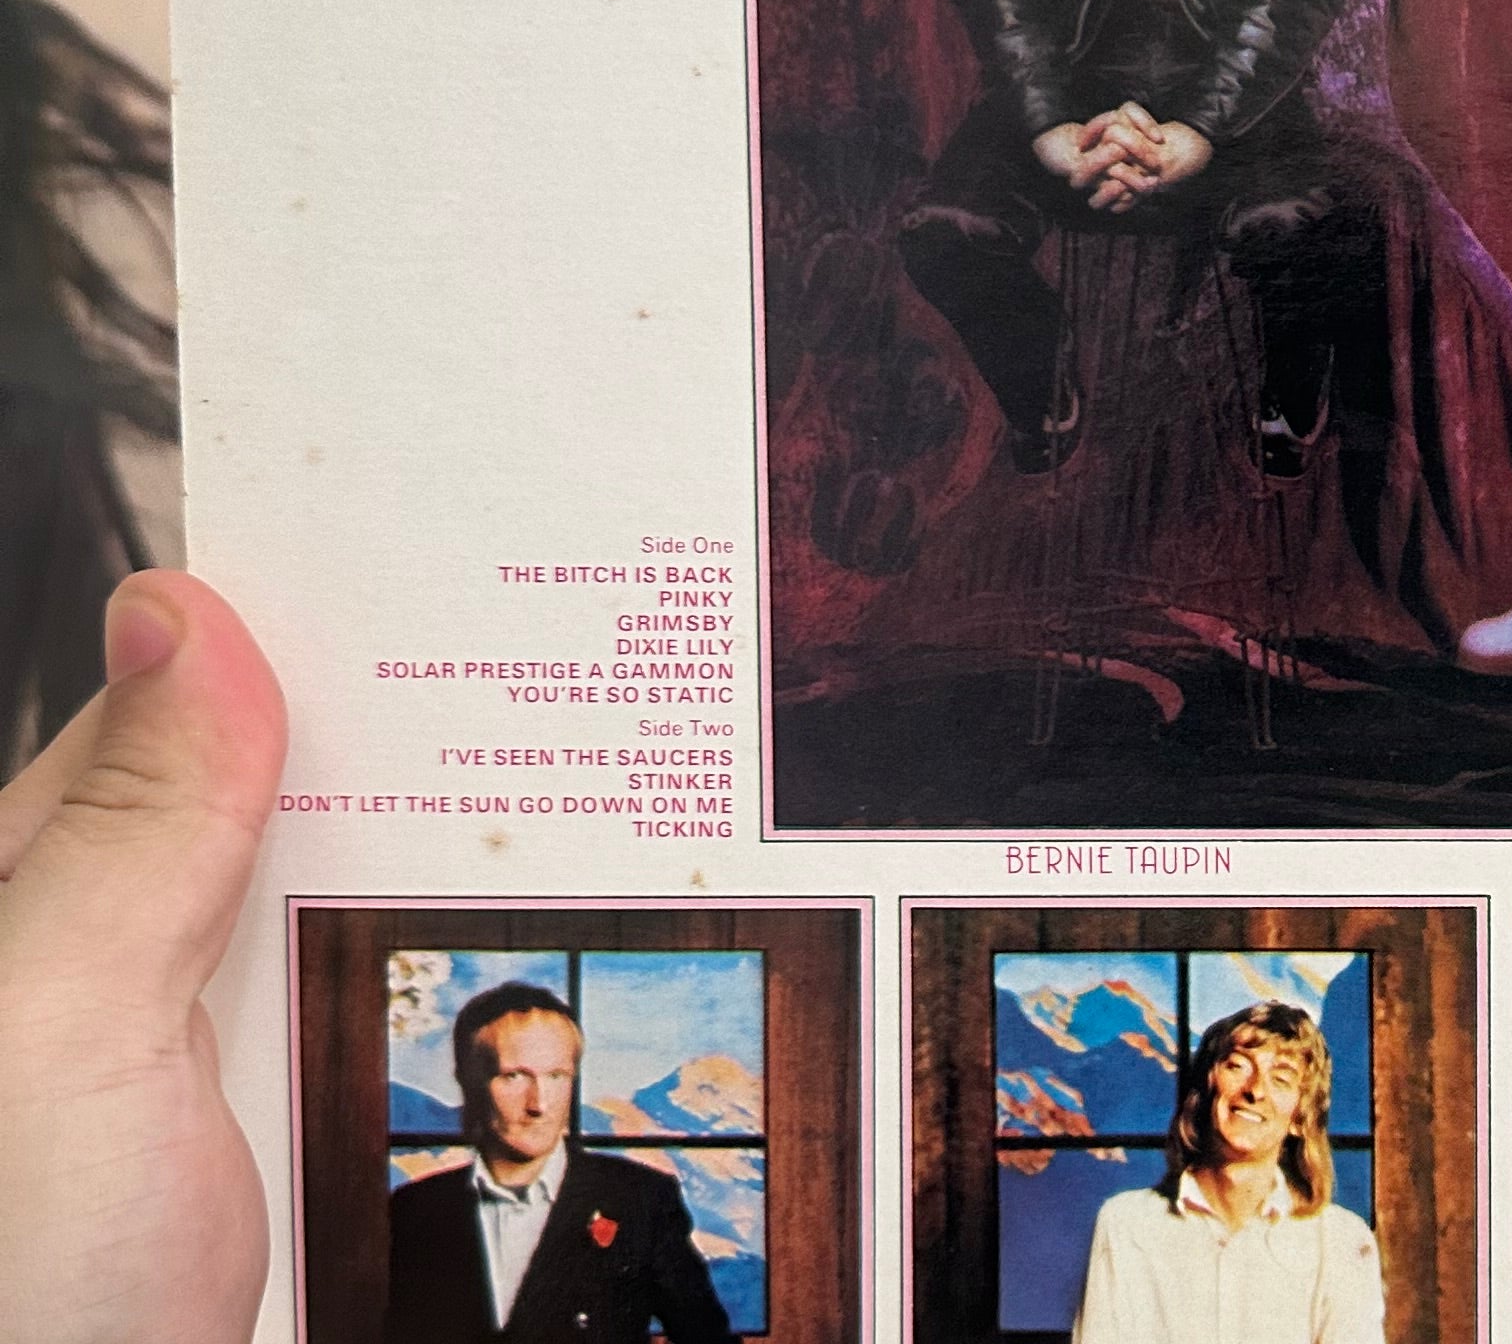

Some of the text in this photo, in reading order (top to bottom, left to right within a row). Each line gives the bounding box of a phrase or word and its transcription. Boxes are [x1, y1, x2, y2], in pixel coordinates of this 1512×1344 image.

[641, 536, 733, 554] Side One
[498, 566, 732, 583] THE BITCH IS BACK
[660, 591, 732, 607] PINKY
[617, 615, 733, 631] GRIMSBY
[617, 639, 733, 655] DIXIE LILY
[377, 662, 733, 679] SOLAR PRESTIGE A GAMMON
[507, 686, 733, 703] YOU'RE SO STATIC
[639, 720, 734, 736] Side Two
[442, 749, 732, 766] I'VE SEEN THE SAUCERS
[629, 773, 732, 790] STINKER
[280, 795, 732, 814] DON'T LET THE SUN GO DOWN ON ME
[632, 821, 732, 838] TICKING
[1006, 846, 1230, 874] BERNIE TAUPIN
